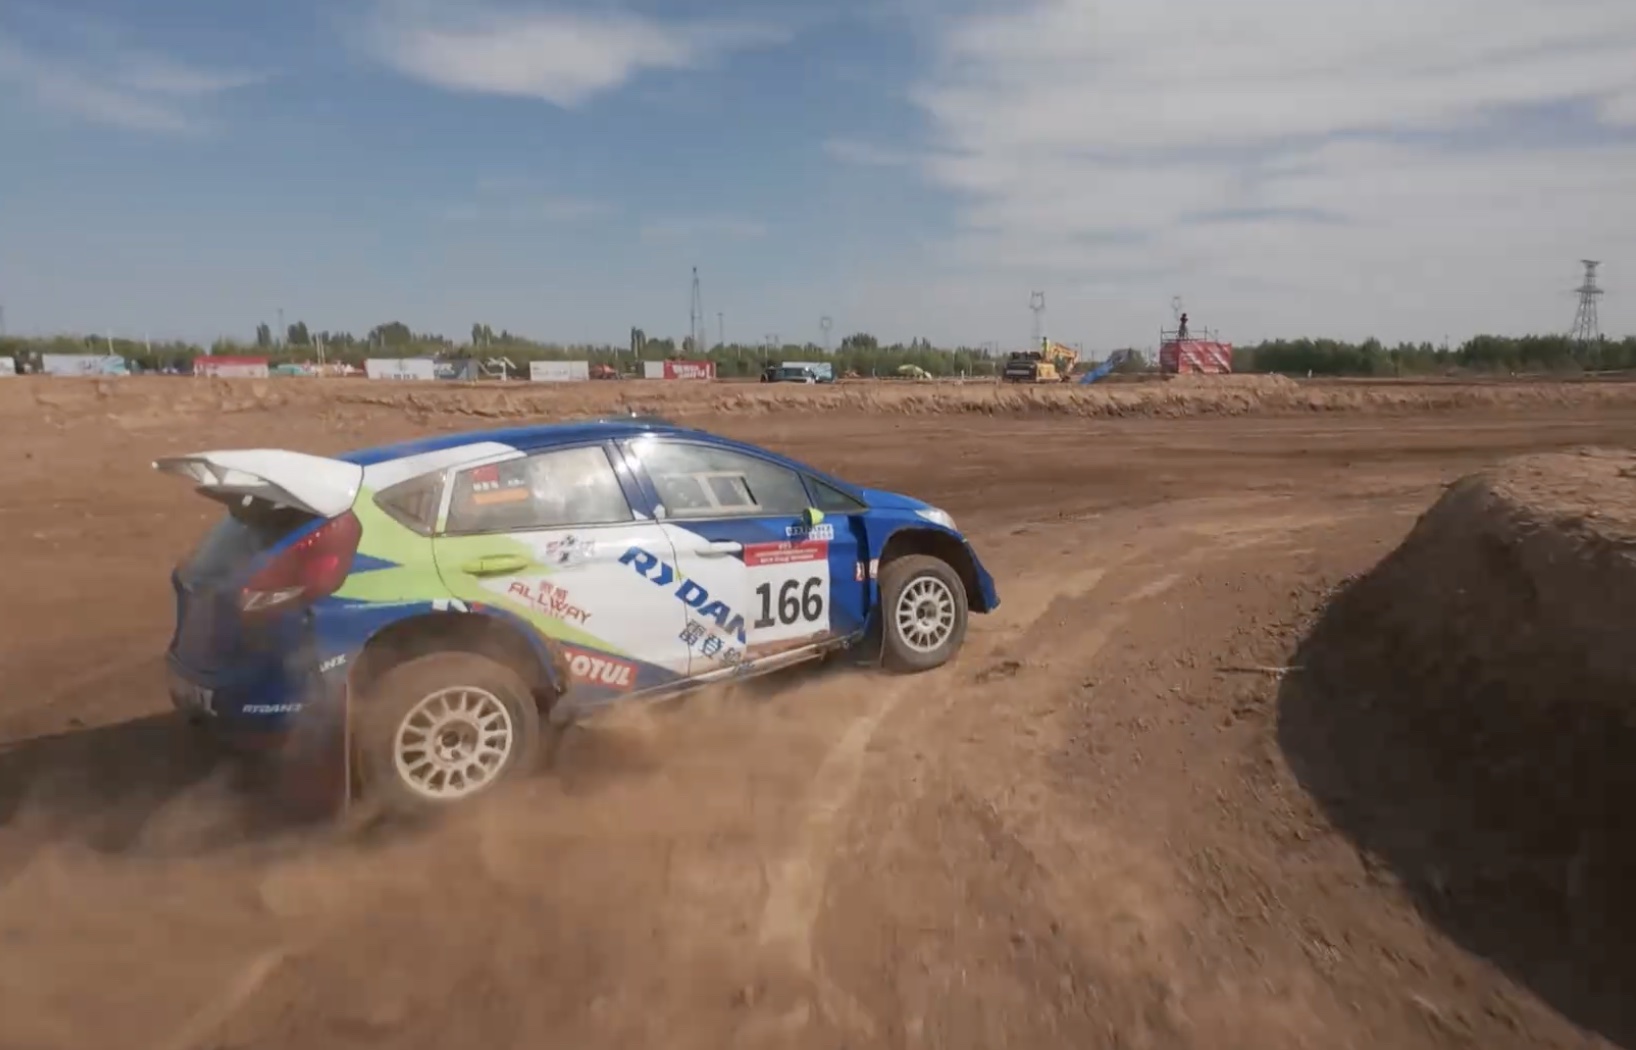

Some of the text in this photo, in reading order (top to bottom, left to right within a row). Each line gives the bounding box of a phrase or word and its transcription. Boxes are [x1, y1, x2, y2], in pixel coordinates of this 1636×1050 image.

[508, 582, 592, 625] ALLWAY
[754, 577, 823, 629] 166
[564, 652, 631, 686] OTUL
